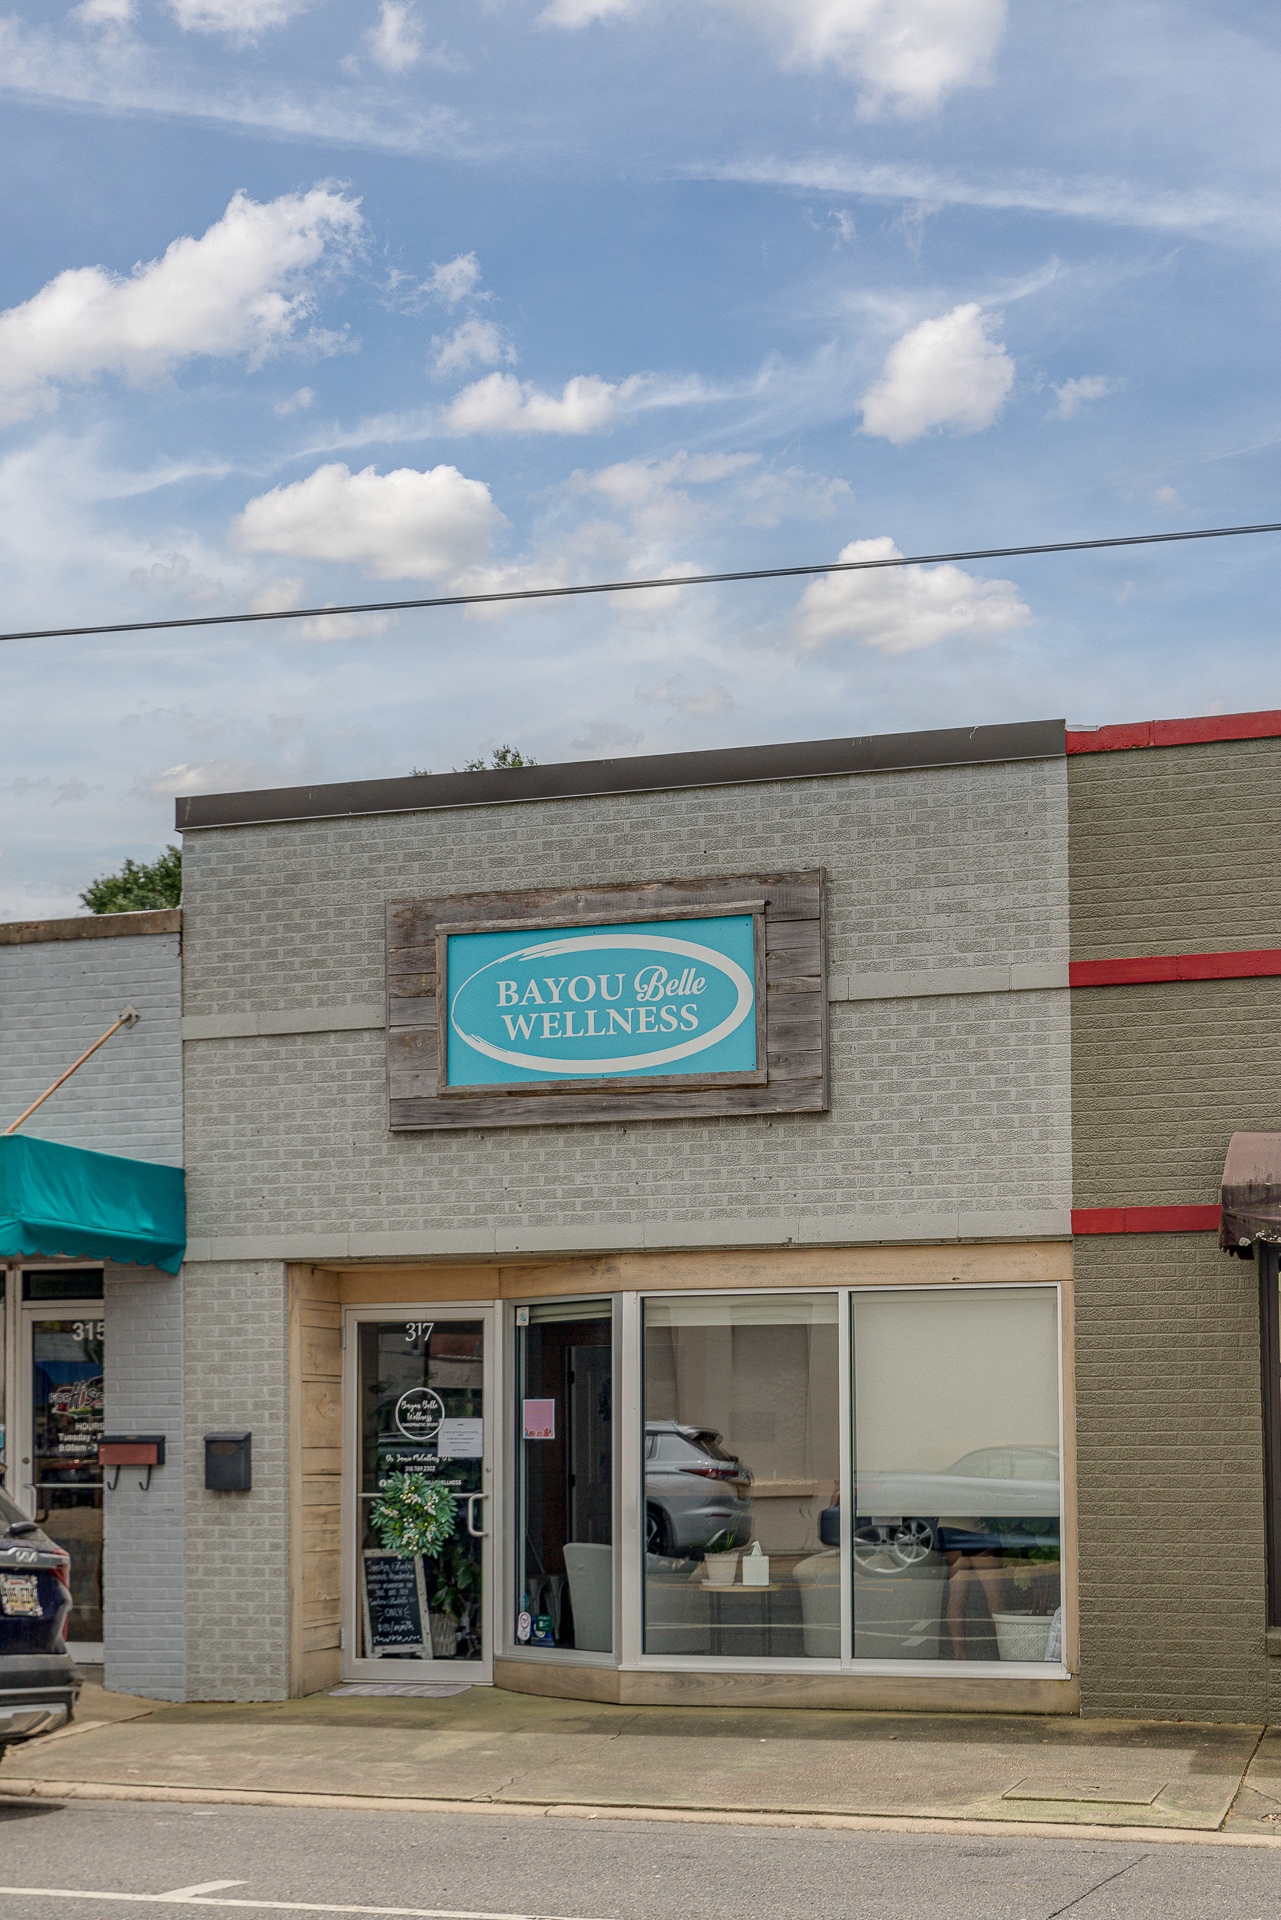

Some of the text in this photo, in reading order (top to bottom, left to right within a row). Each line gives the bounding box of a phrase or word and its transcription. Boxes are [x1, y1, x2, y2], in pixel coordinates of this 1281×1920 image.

[496, 965, 707, 1007] BAYOU Belle
[501, 1003, 699, 1041] WELLNESS
[72, 1322, 104, 1341] 315
[405, 1322, 434, 1342] 317
[422, 1400, 439, 1409] Belle
[75, 1422, 104, 1430] HOURS
[58, 1432, 91, 1443] Tuesday
